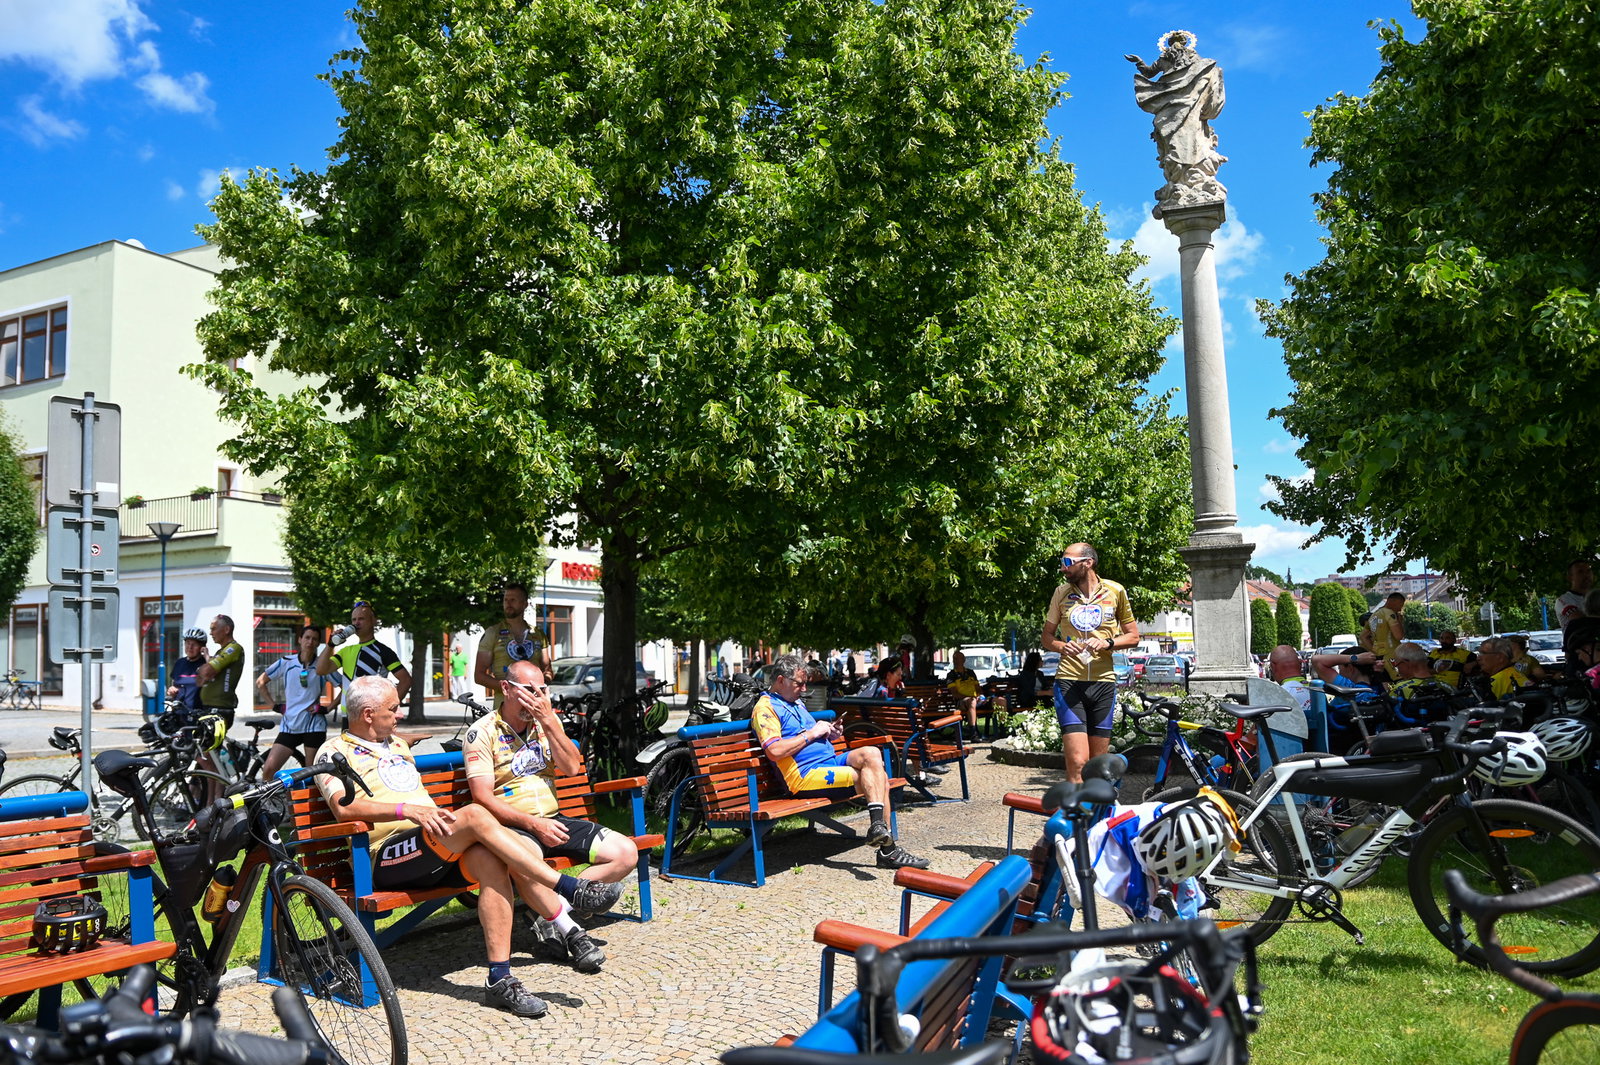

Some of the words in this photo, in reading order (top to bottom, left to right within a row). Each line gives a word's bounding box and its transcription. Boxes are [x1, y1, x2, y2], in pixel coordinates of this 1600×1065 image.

[144, 601, 184, 614] OPTIKA
[255, 596, 296, 609] OPTIK
[382, 836, 418, 860] CTH
[1343, 823, 1410, 873] CANYON
